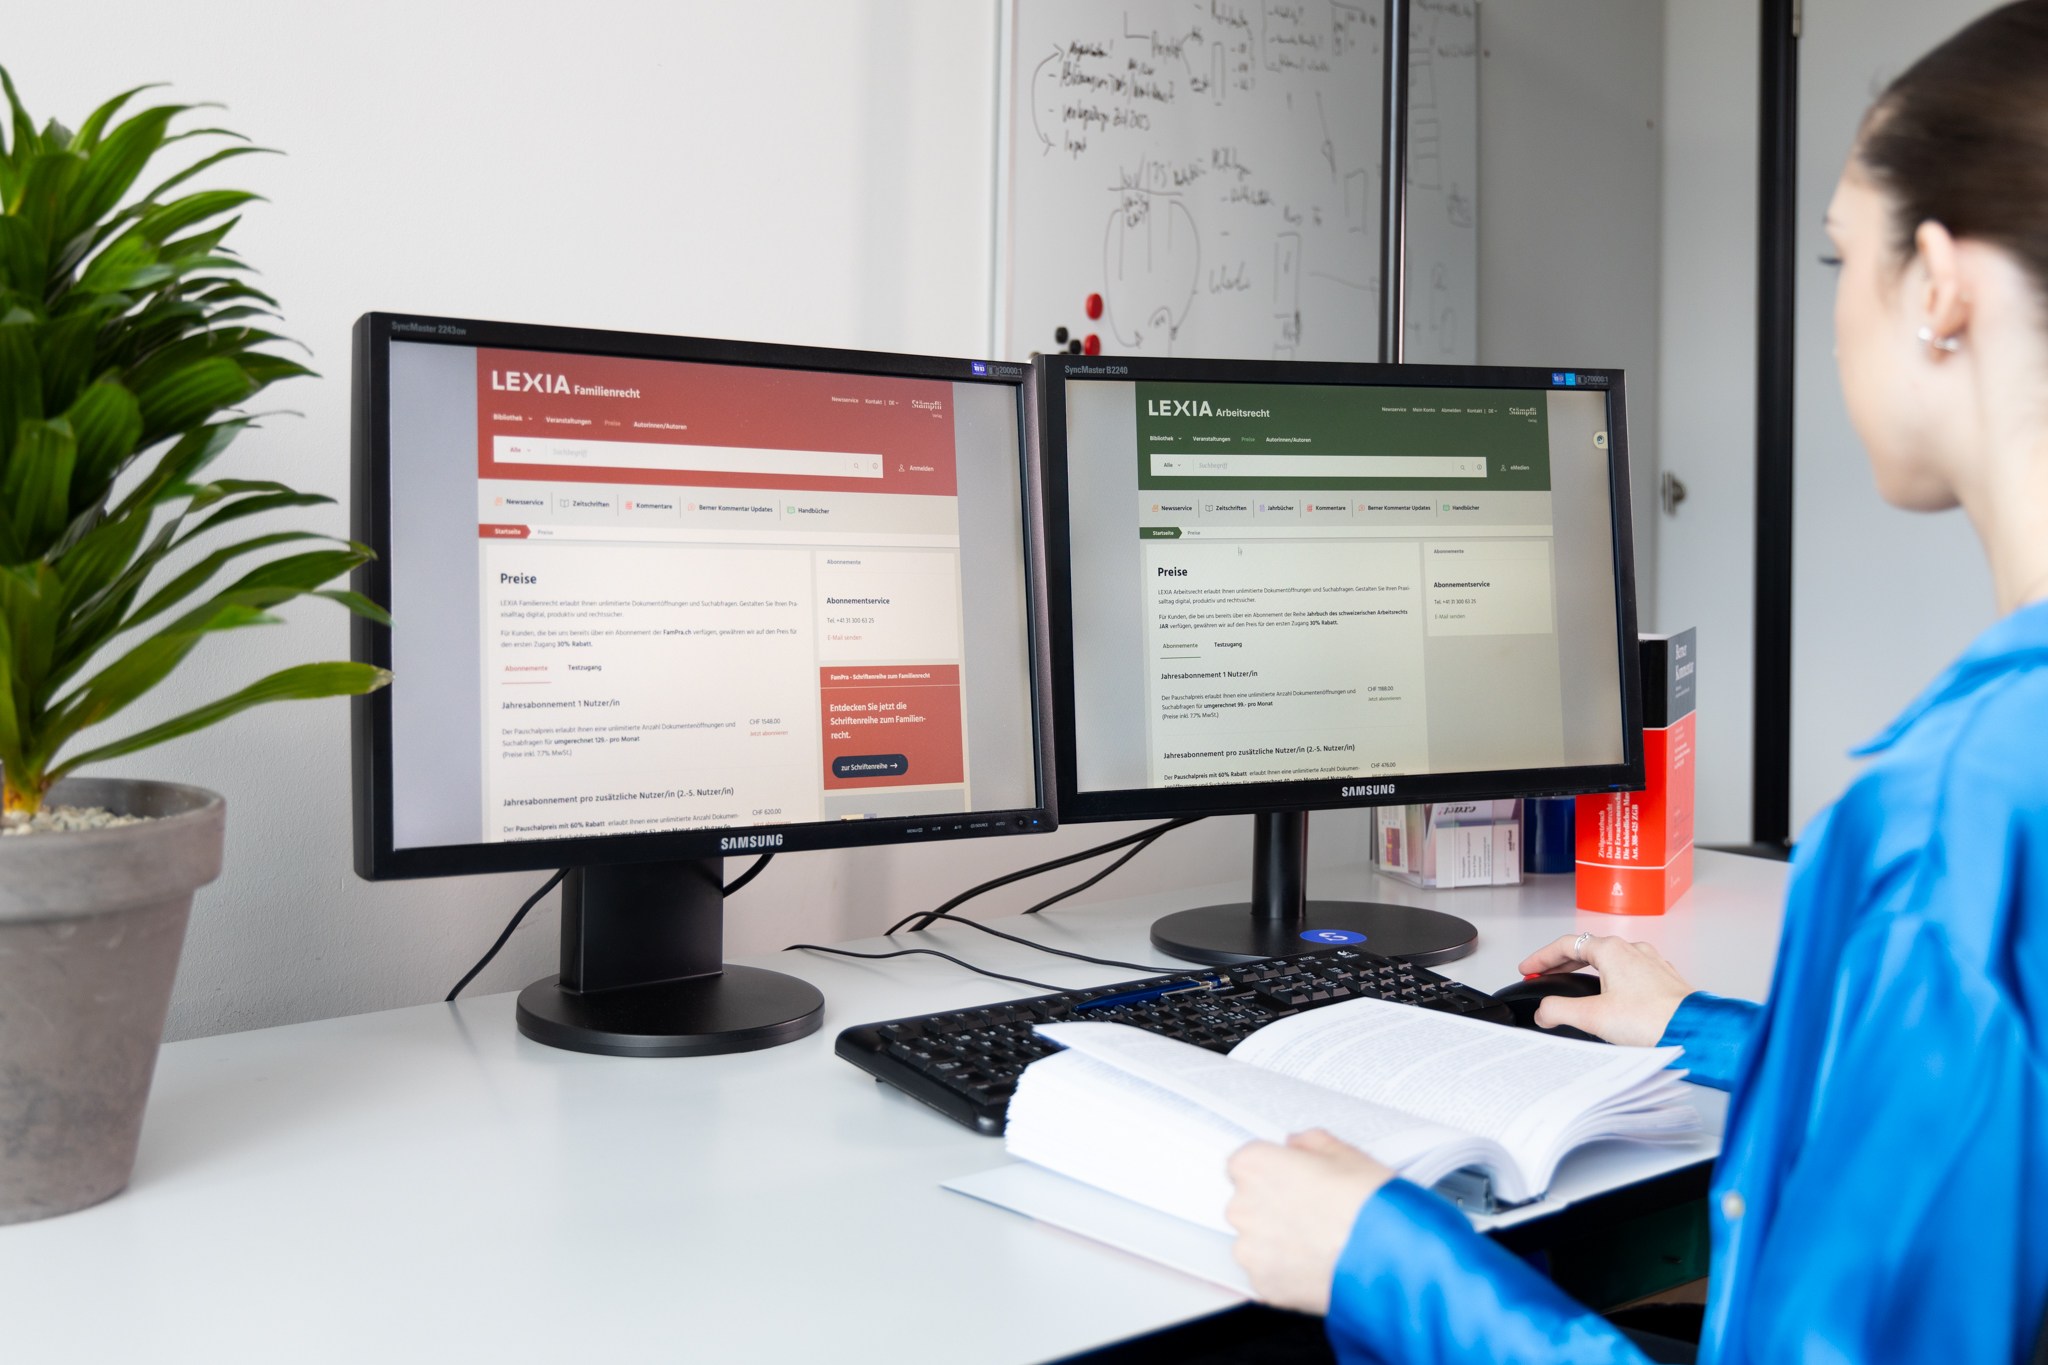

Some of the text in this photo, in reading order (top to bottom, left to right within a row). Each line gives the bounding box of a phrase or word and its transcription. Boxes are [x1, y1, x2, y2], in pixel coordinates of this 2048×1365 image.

[391, 320, 437, 333] SyncMaster
[1064, 365, 1128, 375] SyncMaster B2240
[492, 370, 641, 399] LEXIA Familienrecht
[832, 396, 859, 404] Newsservice
[1148, 399, 1270, 418] LEXIA Arbeitsrecht
[493, 413, 523, 421] Bibliothek
[545, 416, 592, 426] Veranstaltungen
[633, 421, 687, 431] Autorinnen/Autoren
[909, 464, 935, 472] Anmelden
[506, 498, 544, 506] Newsservice
[750, 506, 773, 514] Updates
[798, 507, 830, 515] Handbücher
[1157, 566, 1188, 577] Preise
[500, 572, 537, 584] Preise
[663, 629, 692, 637] FamPra.ch
[568, 664, 602, 672] Testzugang
[1161, 671, 1221, 680] Jahresabonnement
[1227, 670, 1258, 679] Nutzer/in
[502, 700, 576, 710] Jahresabonnement
[583, 699, 620, 708] Nutzer/in
[830, 701, 907, 712] Entdecken Sie jetzt die
[1203, 702, 1236, 710] umgerechnet
[830, 716, 878, 726] Schriftenreihe
[895, 715, 926, 723] Familien-
[554, 737, 594, 746] umgerechnet
[609, 737, 620, 745] pro
[621, 735, 640, 743] Monat
[831, 731, 851, 739] recht.
[1163, 750, 1224, 760] Jahresabonnement
[1225, 750, 1237, 758] pro
[1238, 748, 1274, 757] zusätzliche
[1275, 746, 1305, 755] Nutzer/in
[1323, 744, 1355, 753] Nutzer/in)
[851, 763, 888, 771] Schriftenreihe
[1173, 772, 1208, 780] Pauschalpreis
[1341, 783, 1395, 797] SAMSUNG
[503, 796, 578, 807] Jahresabonnement
[579, 795, 593, 804] pro
[595, 792, 638, 802] zusätzliche
[639, 789, 676, 800] Nutzer/in
[696, 786, 734, 797] Nutzer/in)
[752, 808, 763, 816] CHF
[515, 823, 557, 832] Pauschalpreis
[570, 821, 584, 829] 60%
[585, 820, 605, 828] Rabatt
[1598, 810, 1606, 858] Zivilgesetzbuch
[721, 833, 784, 850] SAMSUNG
